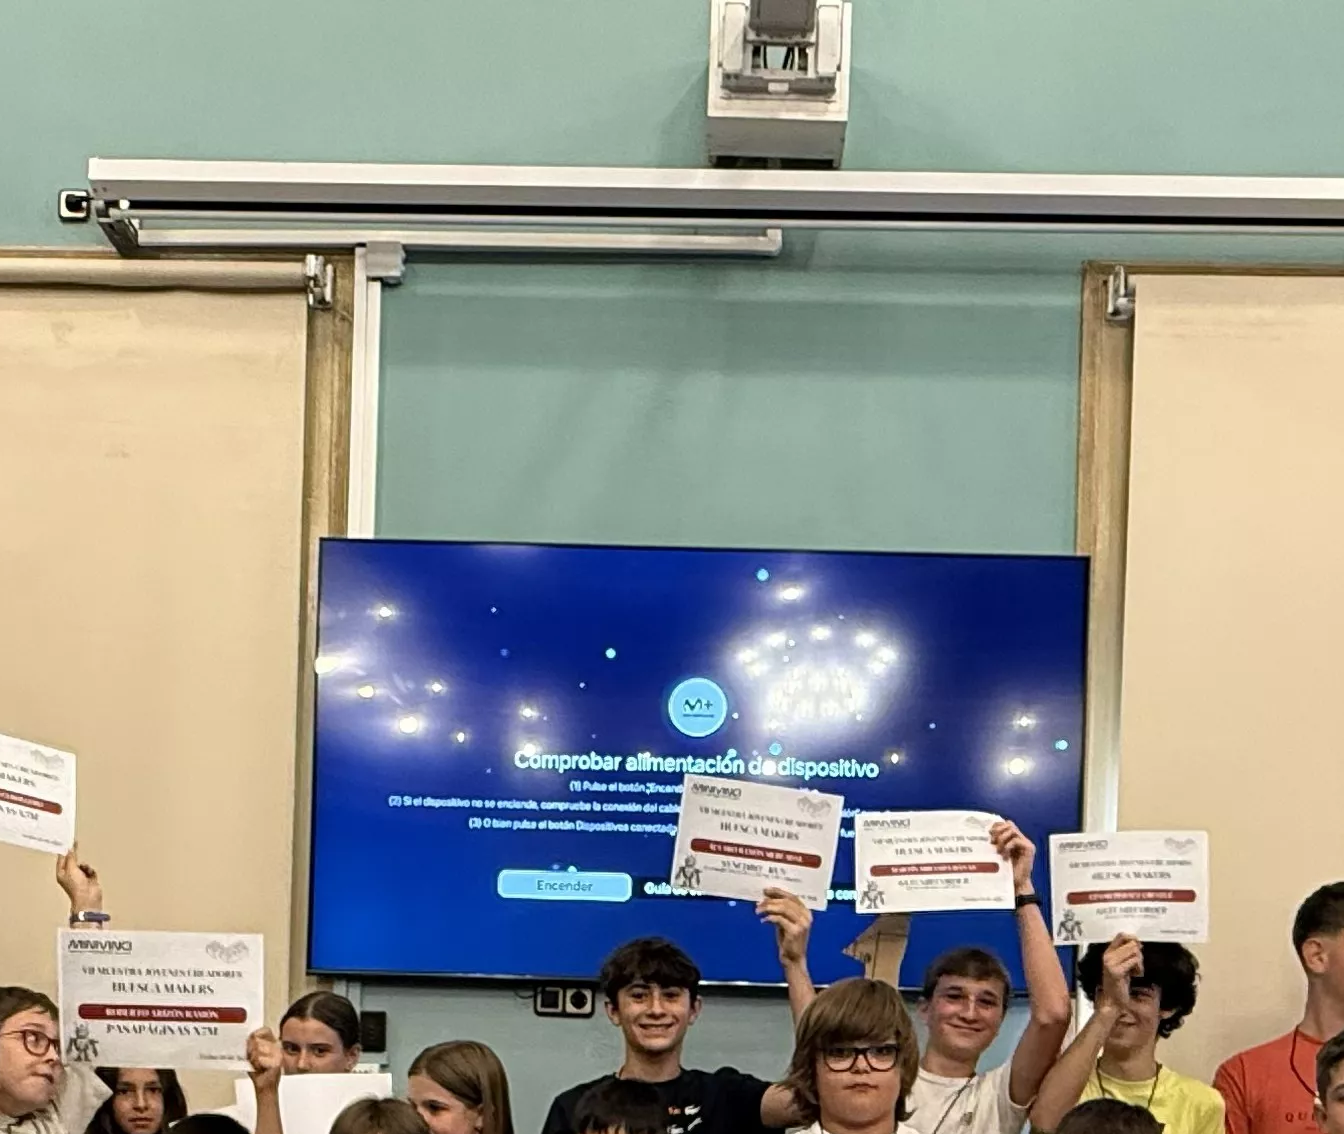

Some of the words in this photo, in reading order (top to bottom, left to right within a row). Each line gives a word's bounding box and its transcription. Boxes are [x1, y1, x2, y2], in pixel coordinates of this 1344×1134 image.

[513, 751, 621, 772] Comprobar
[625, 749, 744, 774] alimentación
[778, 758, 880, 779] dispositivo
[537, 879, 594, 892] Encender
[113, 983, 160, 993] HUESCA
[164, 984, 214, 994] MAKERS
